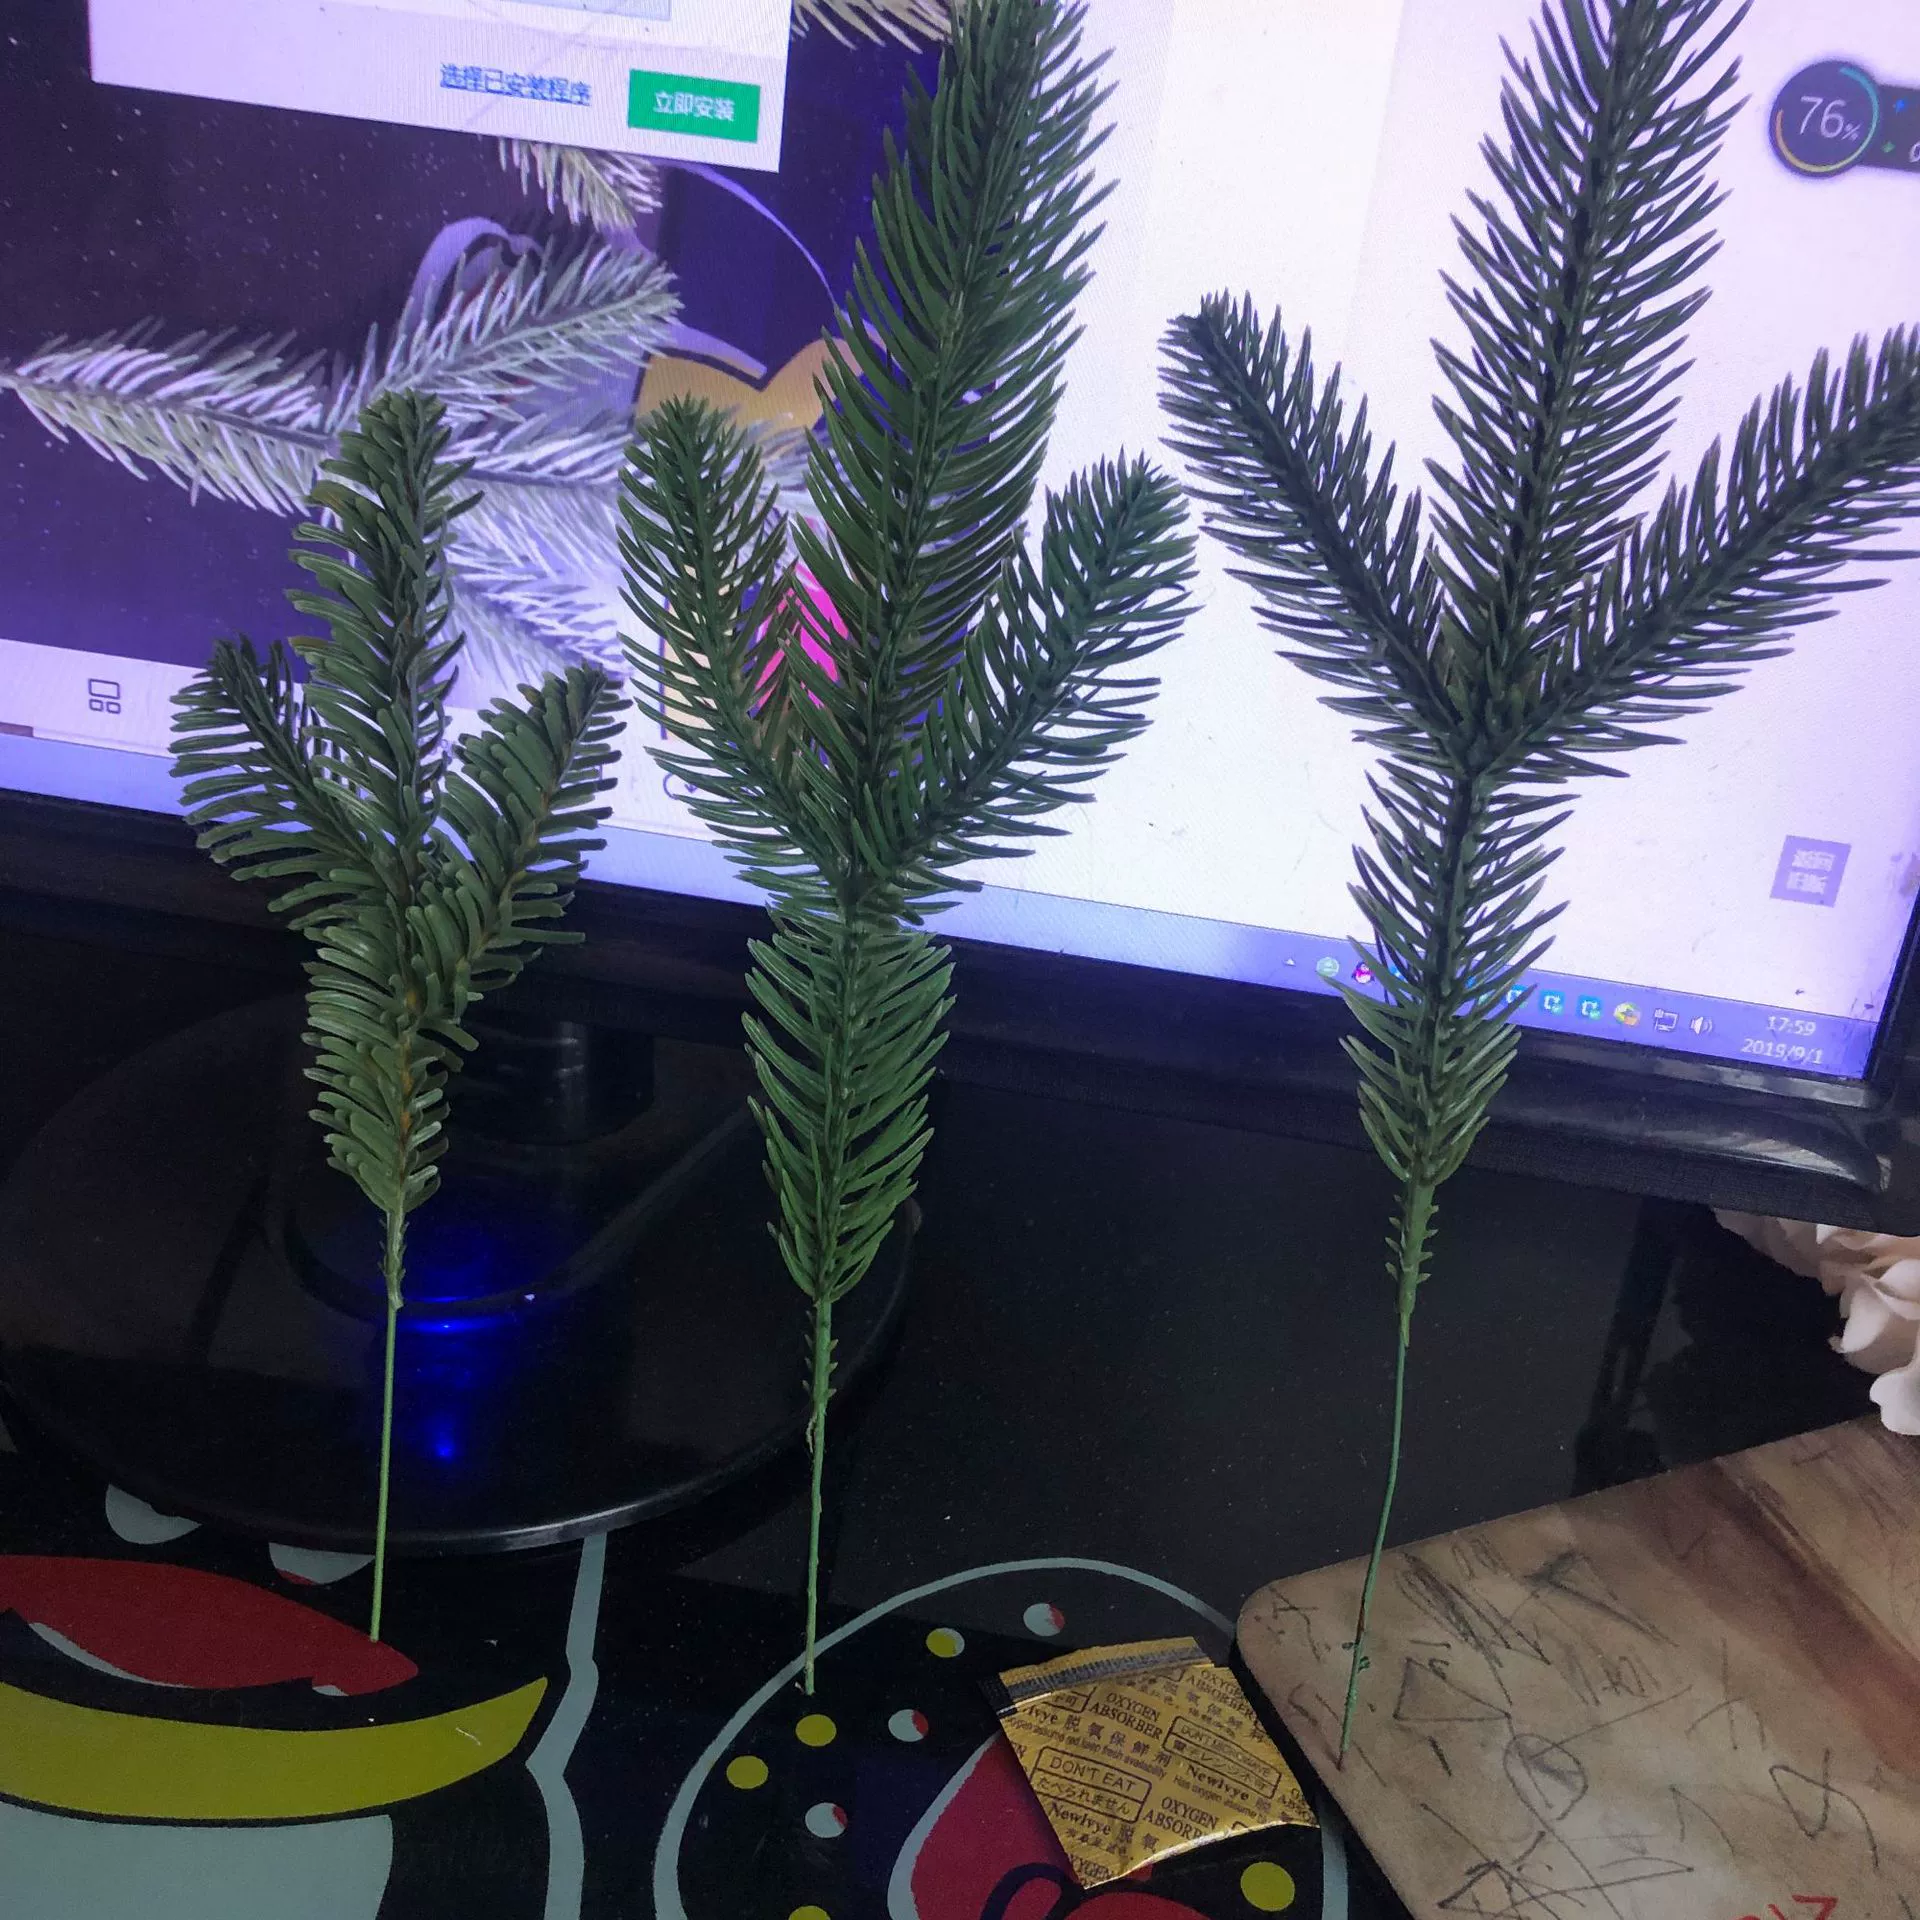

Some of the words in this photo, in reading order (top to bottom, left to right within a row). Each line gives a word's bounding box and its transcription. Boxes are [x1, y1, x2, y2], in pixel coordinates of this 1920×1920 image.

[440, 62, 592, 107] 选择已安装程序
[653, 90, 735, 122] 立即安装
[1799, 95, 1861, 141] 76%
[1767, 1015, 1817, 1036] 17:59
[1741, 1038, 1824, 1065] 2019/9/1
[1089, 1702, 1163, 1740] ABSORBER
[1106, 1692, 1161, 1722] OXYGEN
[1050, 1756, 1099, 1780] DON'T
[1102, 1773, 1137, 1792] EAT
[1037, 1777, 1131, 1815] たべられません
[1161, 1796, 1220, 1831] OXYGEN
